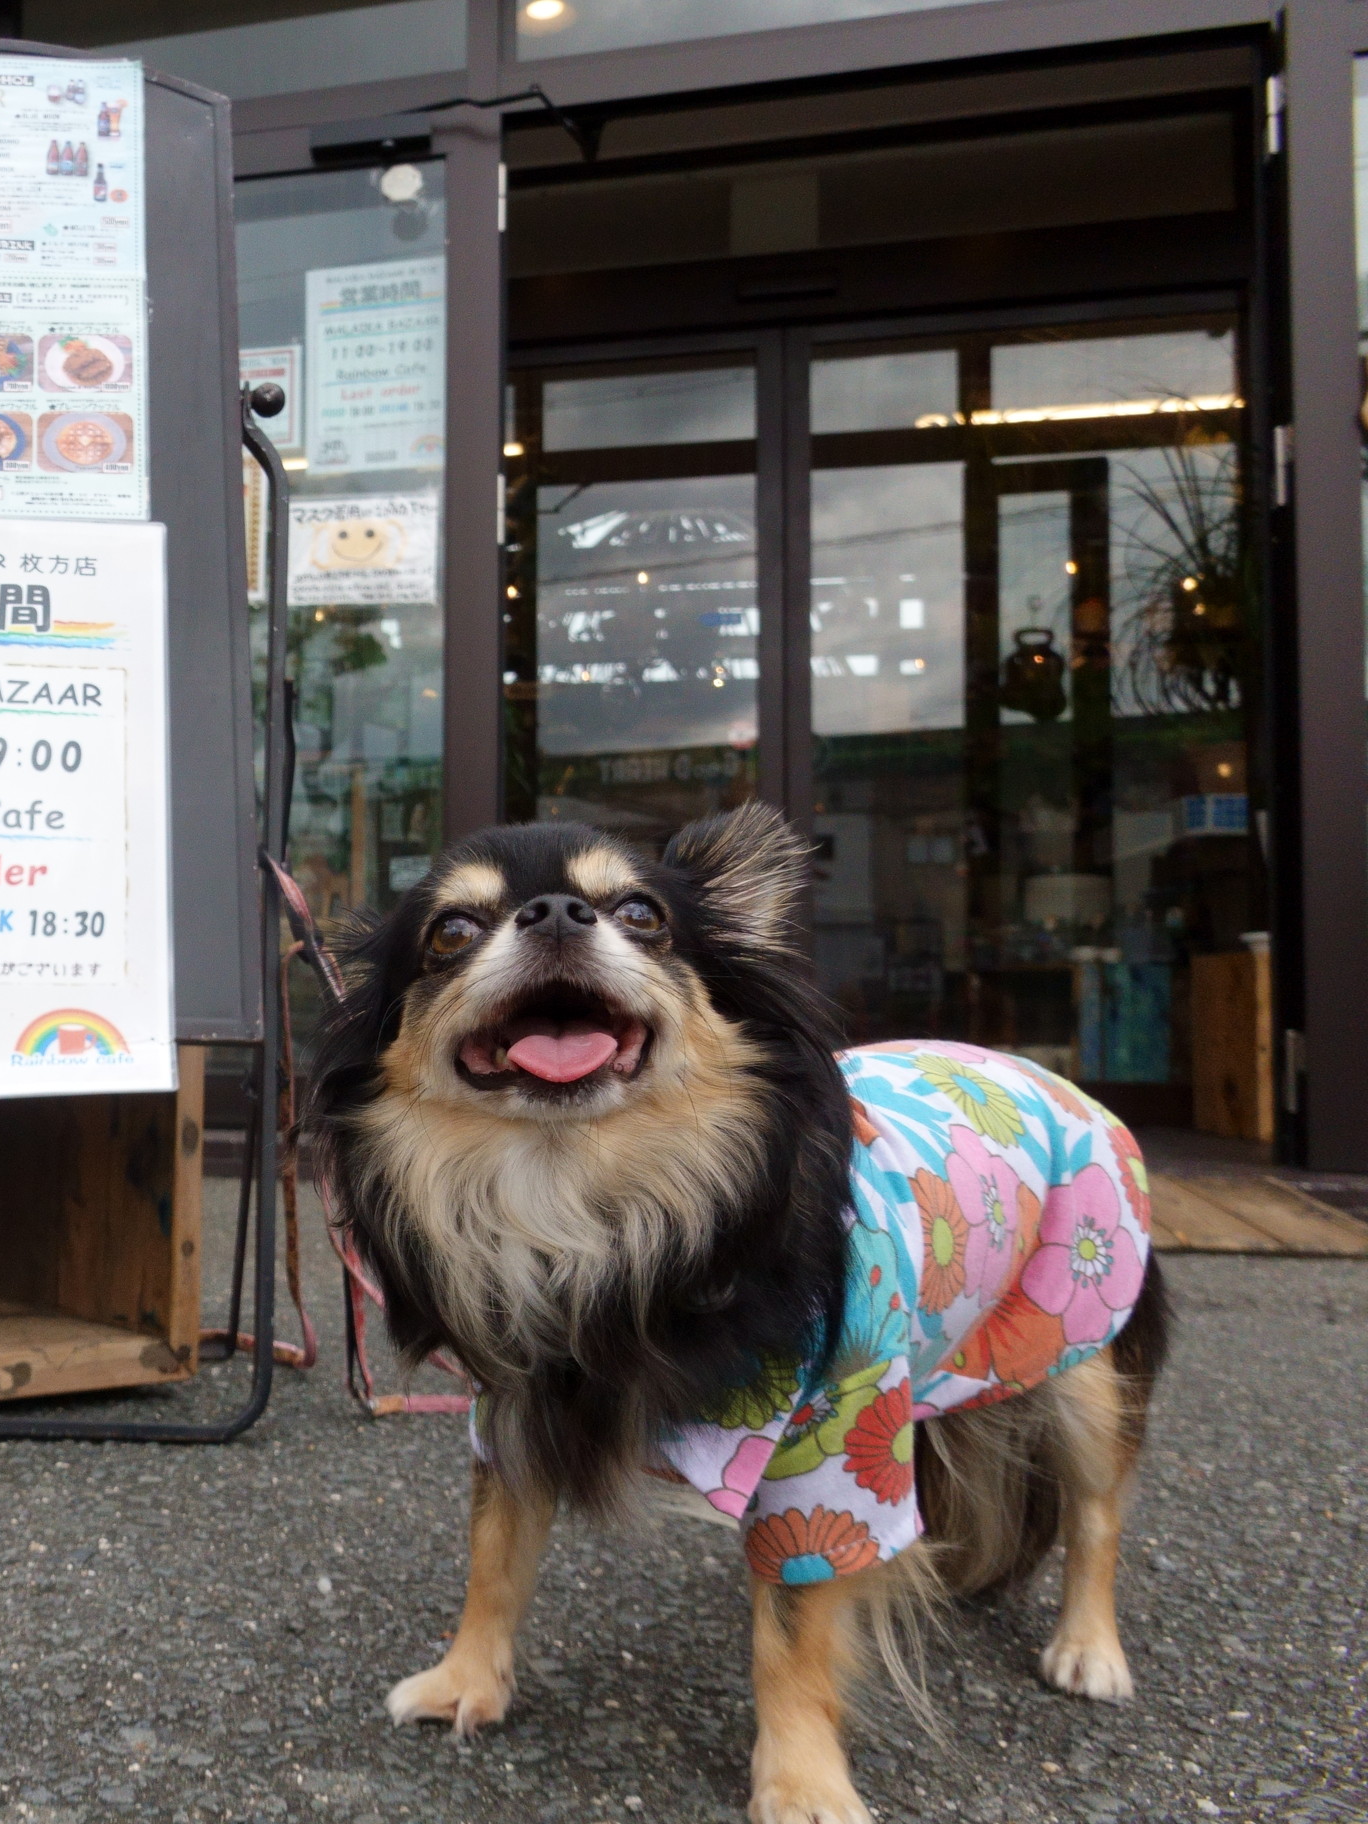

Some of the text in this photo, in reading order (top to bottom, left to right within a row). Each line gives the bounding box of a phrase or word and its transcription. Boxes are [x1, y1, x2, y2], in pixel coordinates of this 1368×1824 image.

[338, 279, 421, 306] 営業時間
[340, 387, 374, 401] Last
[19, 553, 98, 578] 枚方店
[29, 910, 105, 938] 18:30
[11, 1053, 135, 1066] Rainbow cafe
